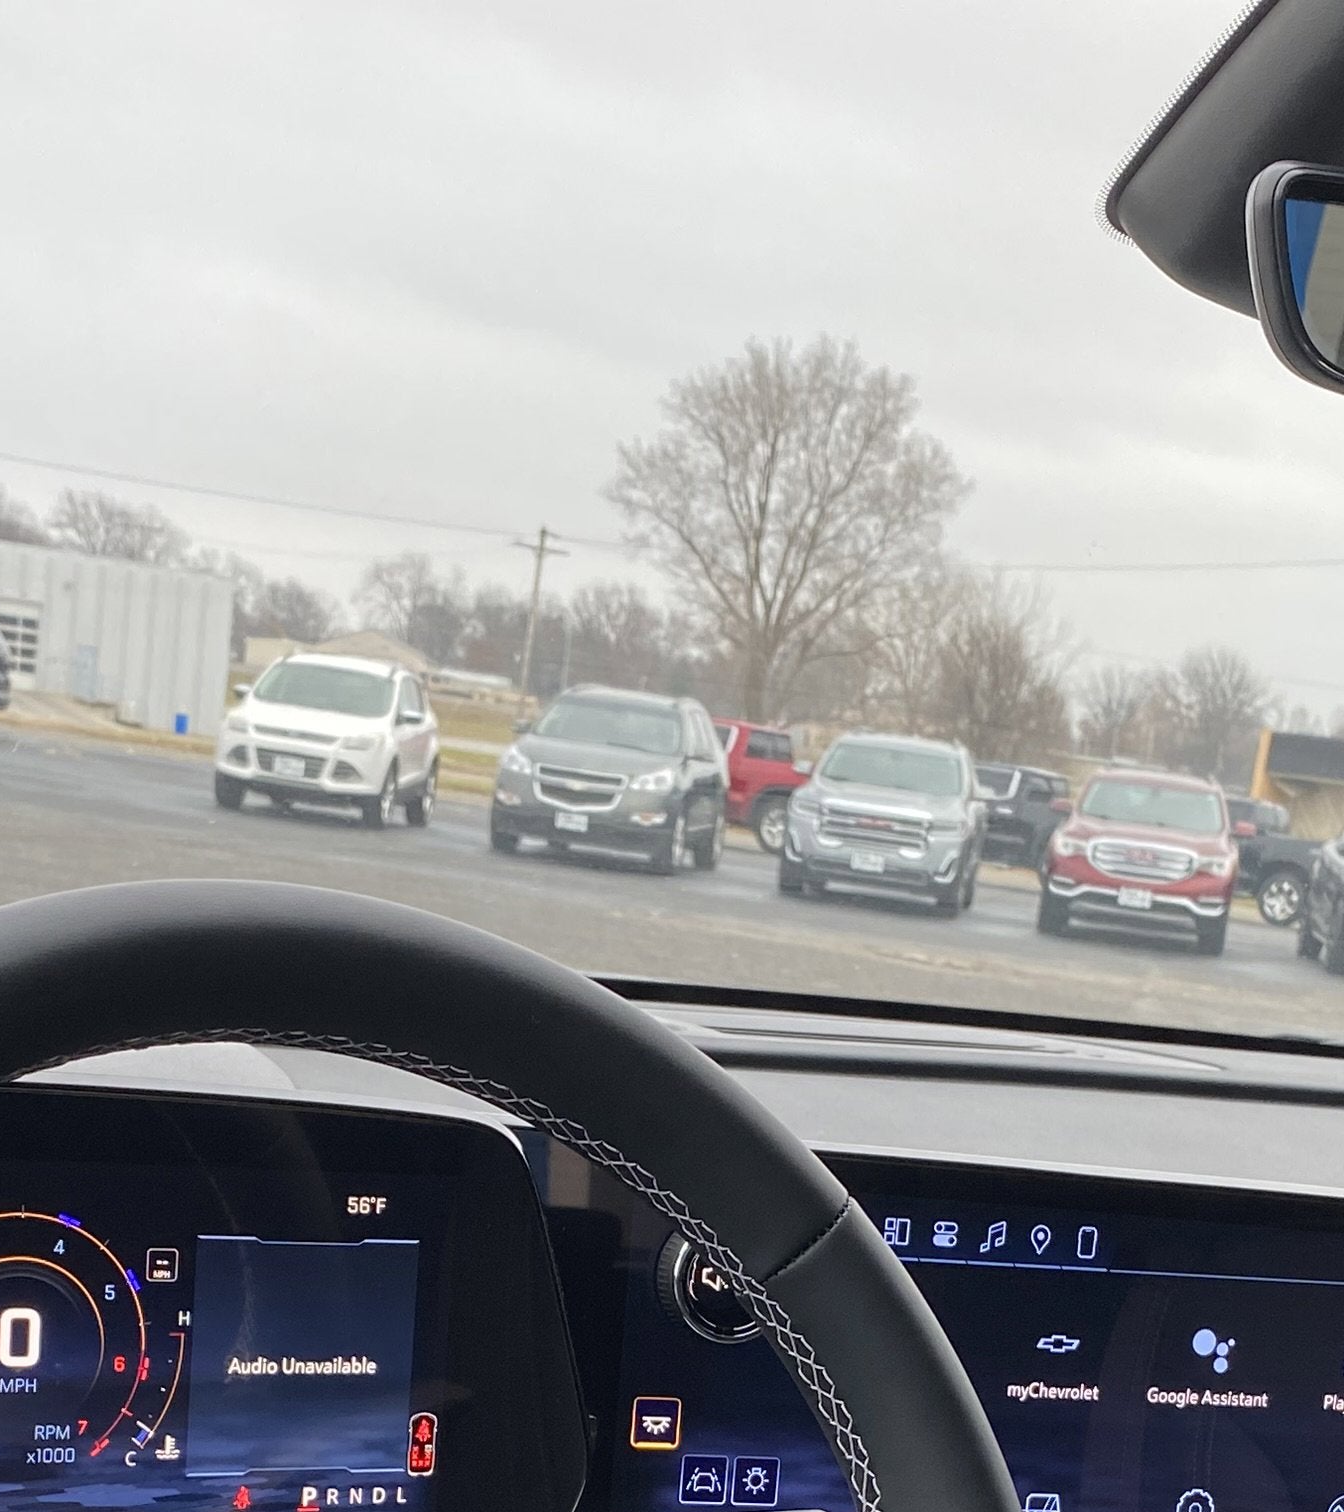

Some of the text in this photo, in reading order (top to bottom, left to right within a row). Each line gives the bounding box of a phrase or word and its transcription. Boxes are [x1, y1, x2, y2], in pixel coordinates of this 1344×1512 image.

[347, 1196, 387, 1215] 56°F
[53, 1239, 65, 1254] 4
[104, 1285, 116, 1300] 5
[178, 1311, 191, 1326] H
[113, 1356, 125, 1372] 6
[227, 1356, 378, 1375] Audio Unavailable
[0, 1378, 38, 1394] MPH
[1007, 1382, 1100, 1403] myChevrolet
[1147, 1387, 1269, 1409] Google Assistant
[34, 1425, 71, 1441] RPM
[77, 1420, 88, 1435] 7
[26, 1448, 76, 1464] x1000
[124, 1451, 137, 1467] C
[301, 1486, 407, 1507] P R N D L
